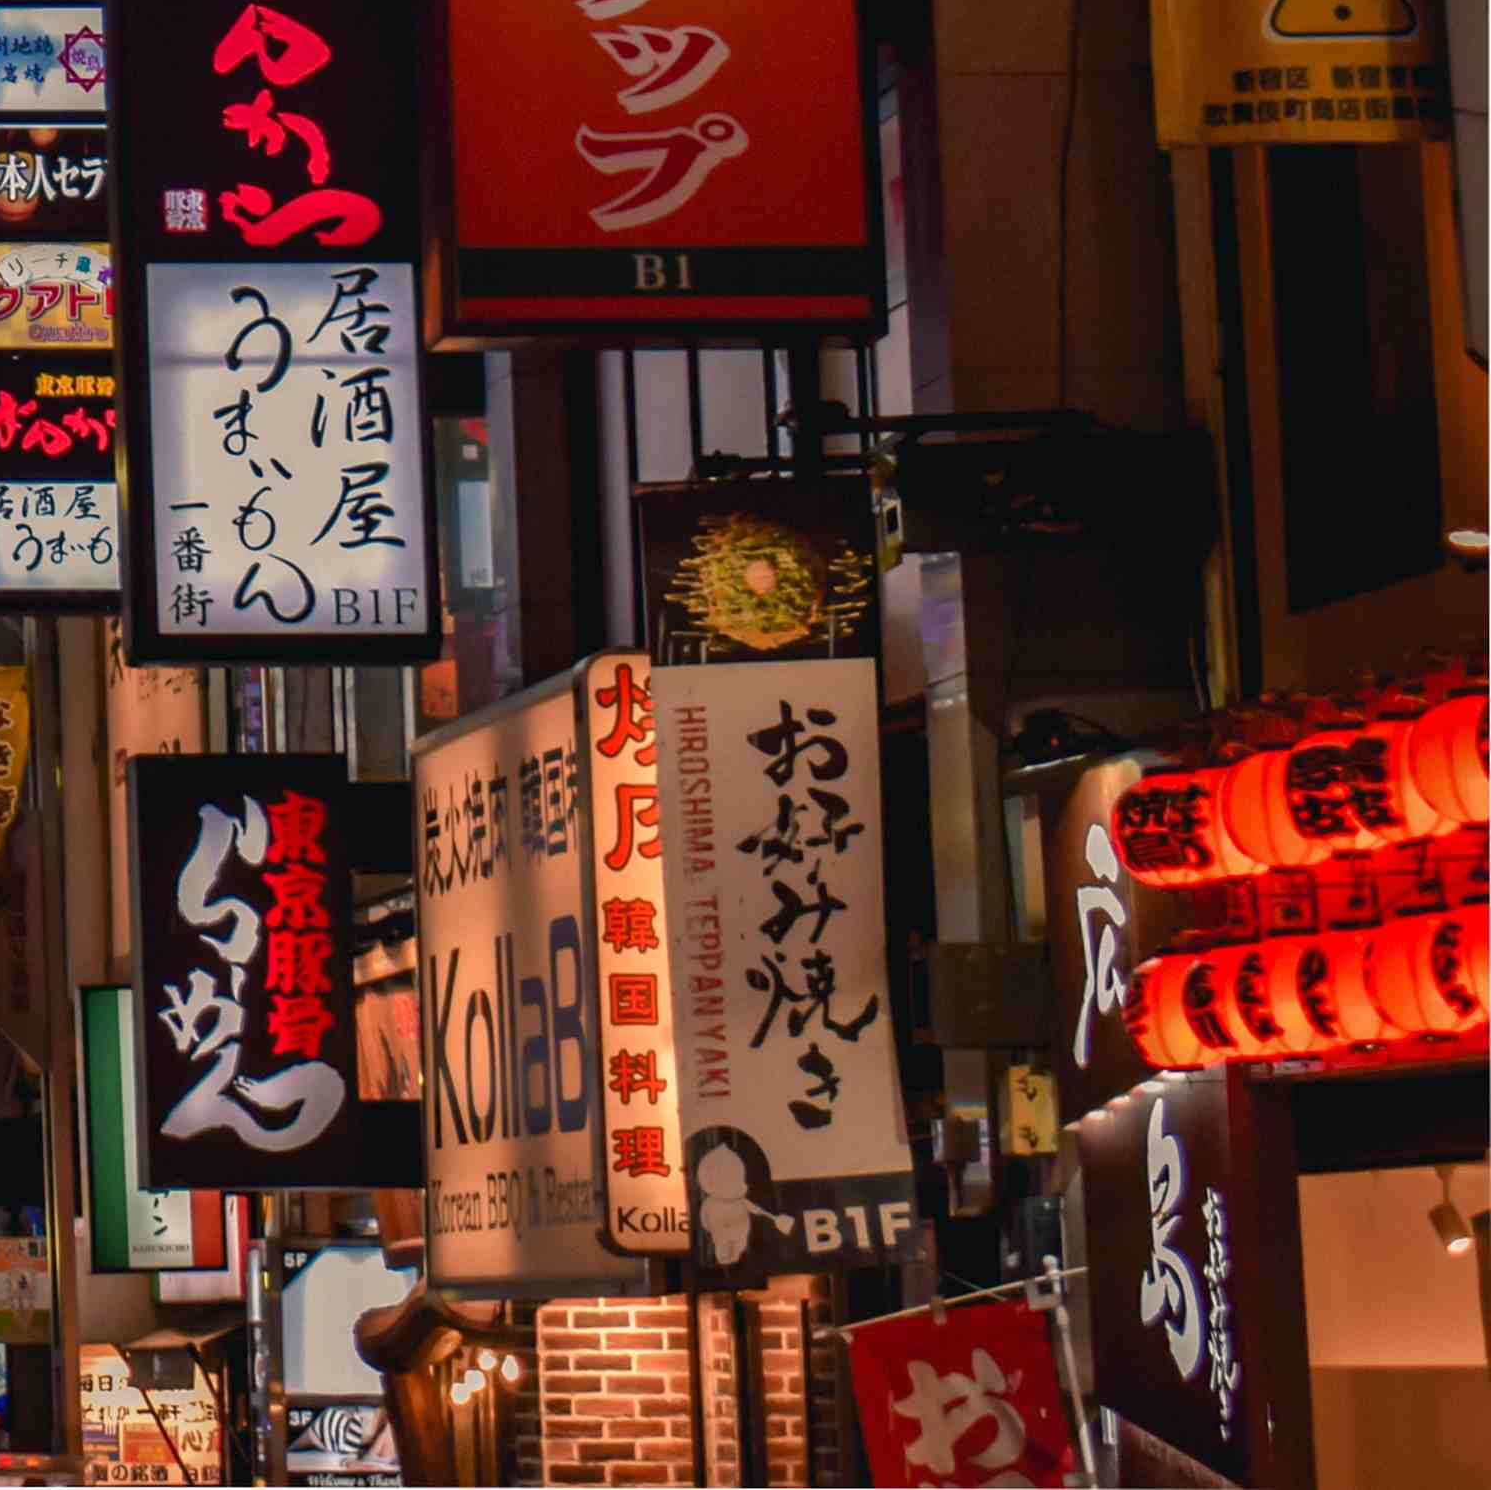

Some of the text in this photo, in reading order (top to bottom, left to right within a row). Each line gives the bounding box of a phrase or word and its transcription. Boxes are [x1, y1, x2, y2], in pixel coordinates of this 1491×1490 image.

[632, 253, 694, 291] B1
[308, 266, 406, 550] 居酒屋
[169, 499, 215, 627] 一番街
[332, 586, 419, 627] B1F
[672, 706, 732, 1100] HIROSHIMA TEPPANYAKI
[603, 898, 671, 1180] 韓国料理
[802, 1201, 915, 1255] B1F
